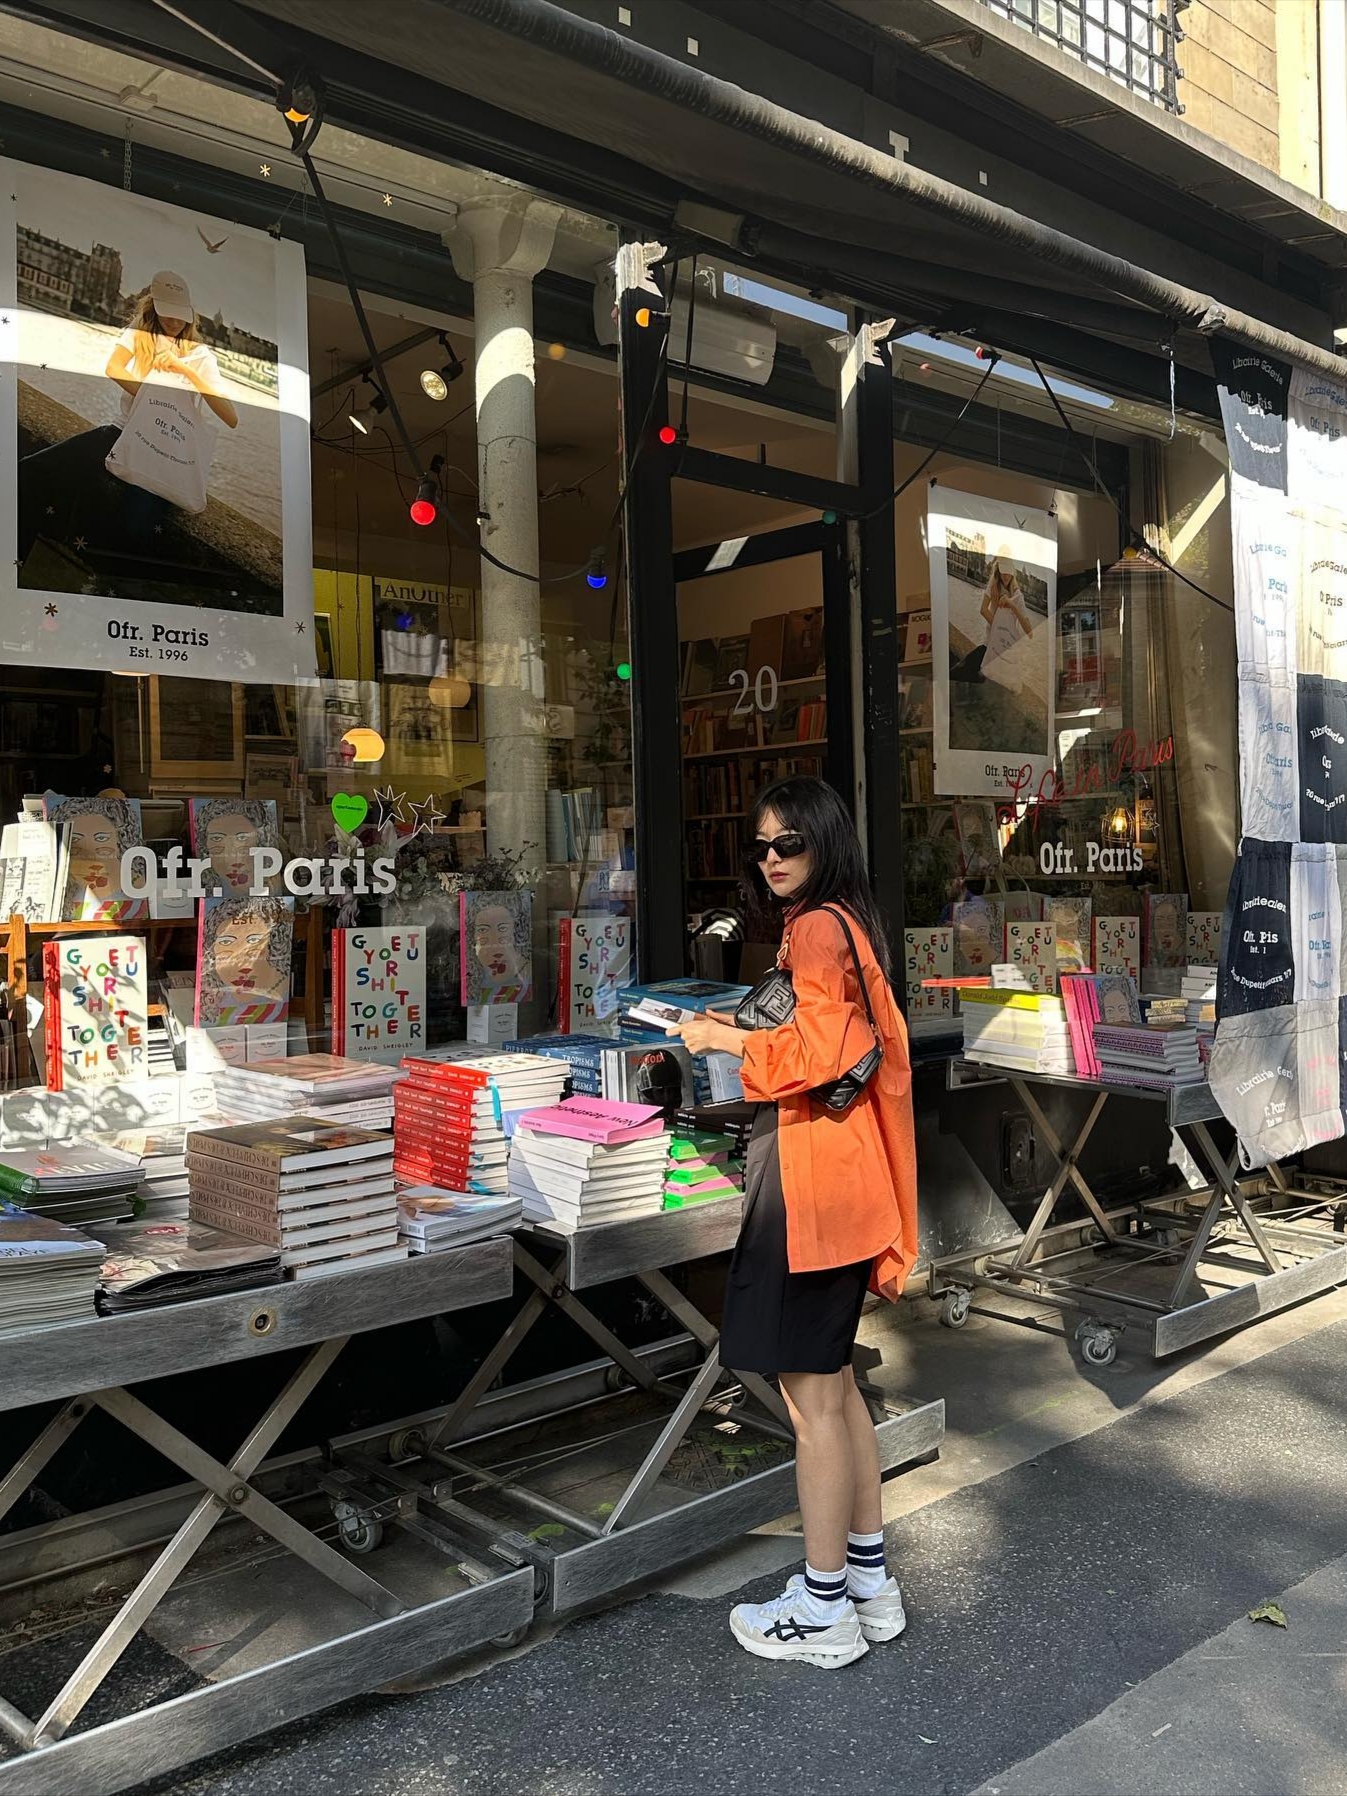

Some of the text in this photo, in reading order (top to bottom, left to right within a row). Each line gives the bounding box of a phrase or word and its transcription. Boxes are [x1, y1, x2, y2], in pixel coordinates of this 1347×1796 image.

[107, 619, 209, 647] Ofr. Paris
[129, 646, 188, 661] Est. 1996
[728, 665, 777, 715] 20
[985, 764, 1025, 778] Ofr. Paris
[1108, 727, 1174, 782] Paris
[120, 845, 398, 899] Ofr. Paris
[1040, 841, 1144, 875] Ofr. Paris
